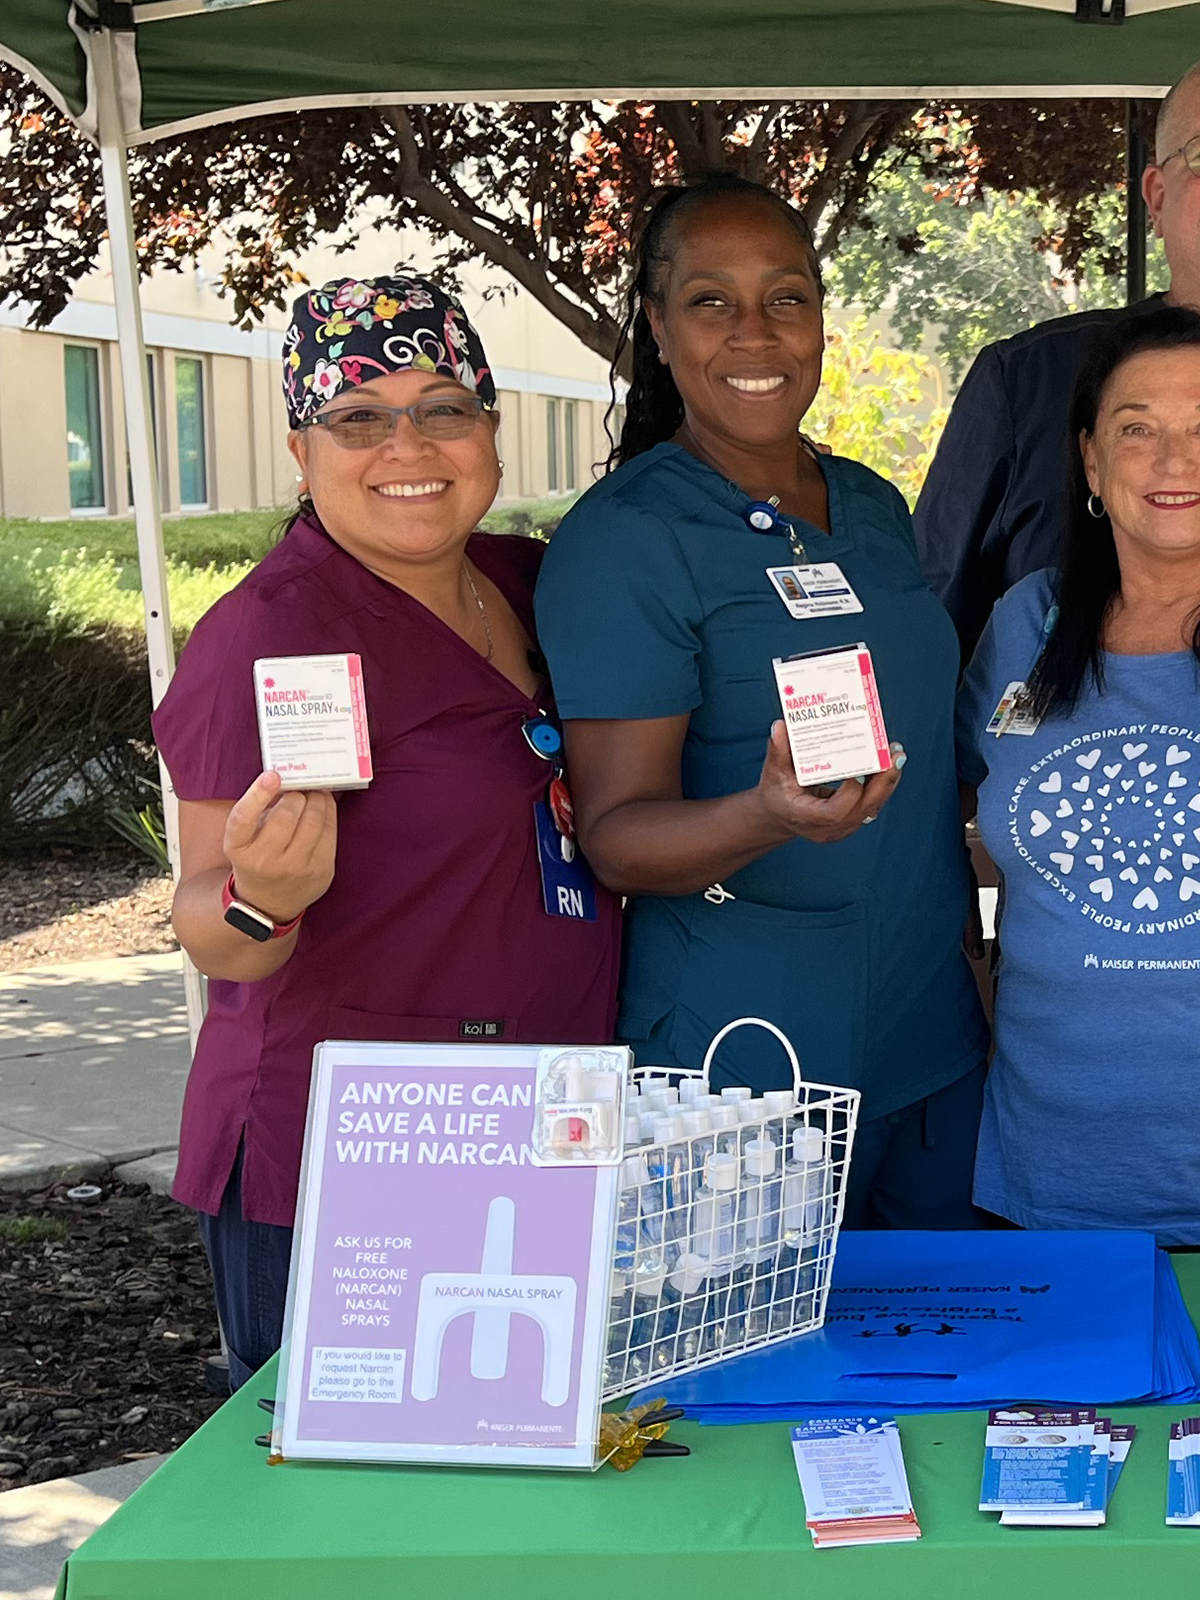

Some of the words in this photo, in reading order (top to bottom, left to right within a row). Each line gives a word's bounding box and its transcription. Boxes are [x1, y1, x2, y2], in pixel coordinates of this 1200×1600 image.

[266, 704, 299, 718] NASAL
[302, 702, 333, 716] SPRAY
[788, 706, 819, 723] NASAL
[820, 702, 850, 717] SPRAY
[1030, 724, 1147, 773] EXTRAORDINARY
[1008, 817, 1076, 903] EXCEPTIONAL
[556, 886, 584, 918] RN
[1102, 960, 1134, 970] KAISER
[340, 1082, 464, 1106] ANYONE
[471, 1084, 532, 1107] CAN
[337, 1112, 411, 1135] SAVE
[416, 1113, 437, 1135] A
[444, 1113, 500, 1136] LIFE
[335, 1141, 410, 1164] WITH
[418, 1142, 534, 1166] NARCAN
[334, 1236, 361, 1249] ASK
[364, 1237, 381, 1249] US
[384, 1237, 412, 1250] FOR
[355, 1252, 388, 1264] FREE
[332, 1268, 408, 1280] NALOXONE
[335, 1282, 403, 1297] (NARCAN)
[435, 1286, 485, 1298] NARCAN
[487, 1287, 525, 1299] NASAL
[527, 1288, 563, 1300] SPRAY
[345, 1299, 390, 1311] NASAL
[340, 1314, 391, 1327] SPRAYS
[316, 1350, 323, 1359] If
[324, 1352, 342, 1361] you
[344, 1351, 372, 1360] would
[374, 1352, 391, 1361] like
[394, 1352, 403, 1361] to
[322, 1364, 357, 1374] request
[360, 1364, 394, 1374] Narcan
[318, 1376, 350, 1387] please
[352, 1379, 365, 1388] go
[368, 1378, 376, 1386] to
[380, 1378, 394, 1387] the
[312, 1388, 365, 1400] Emergency
[368, 1390, 398, 1400] Room.
[490, 1424, 514, 1432] KAISER
